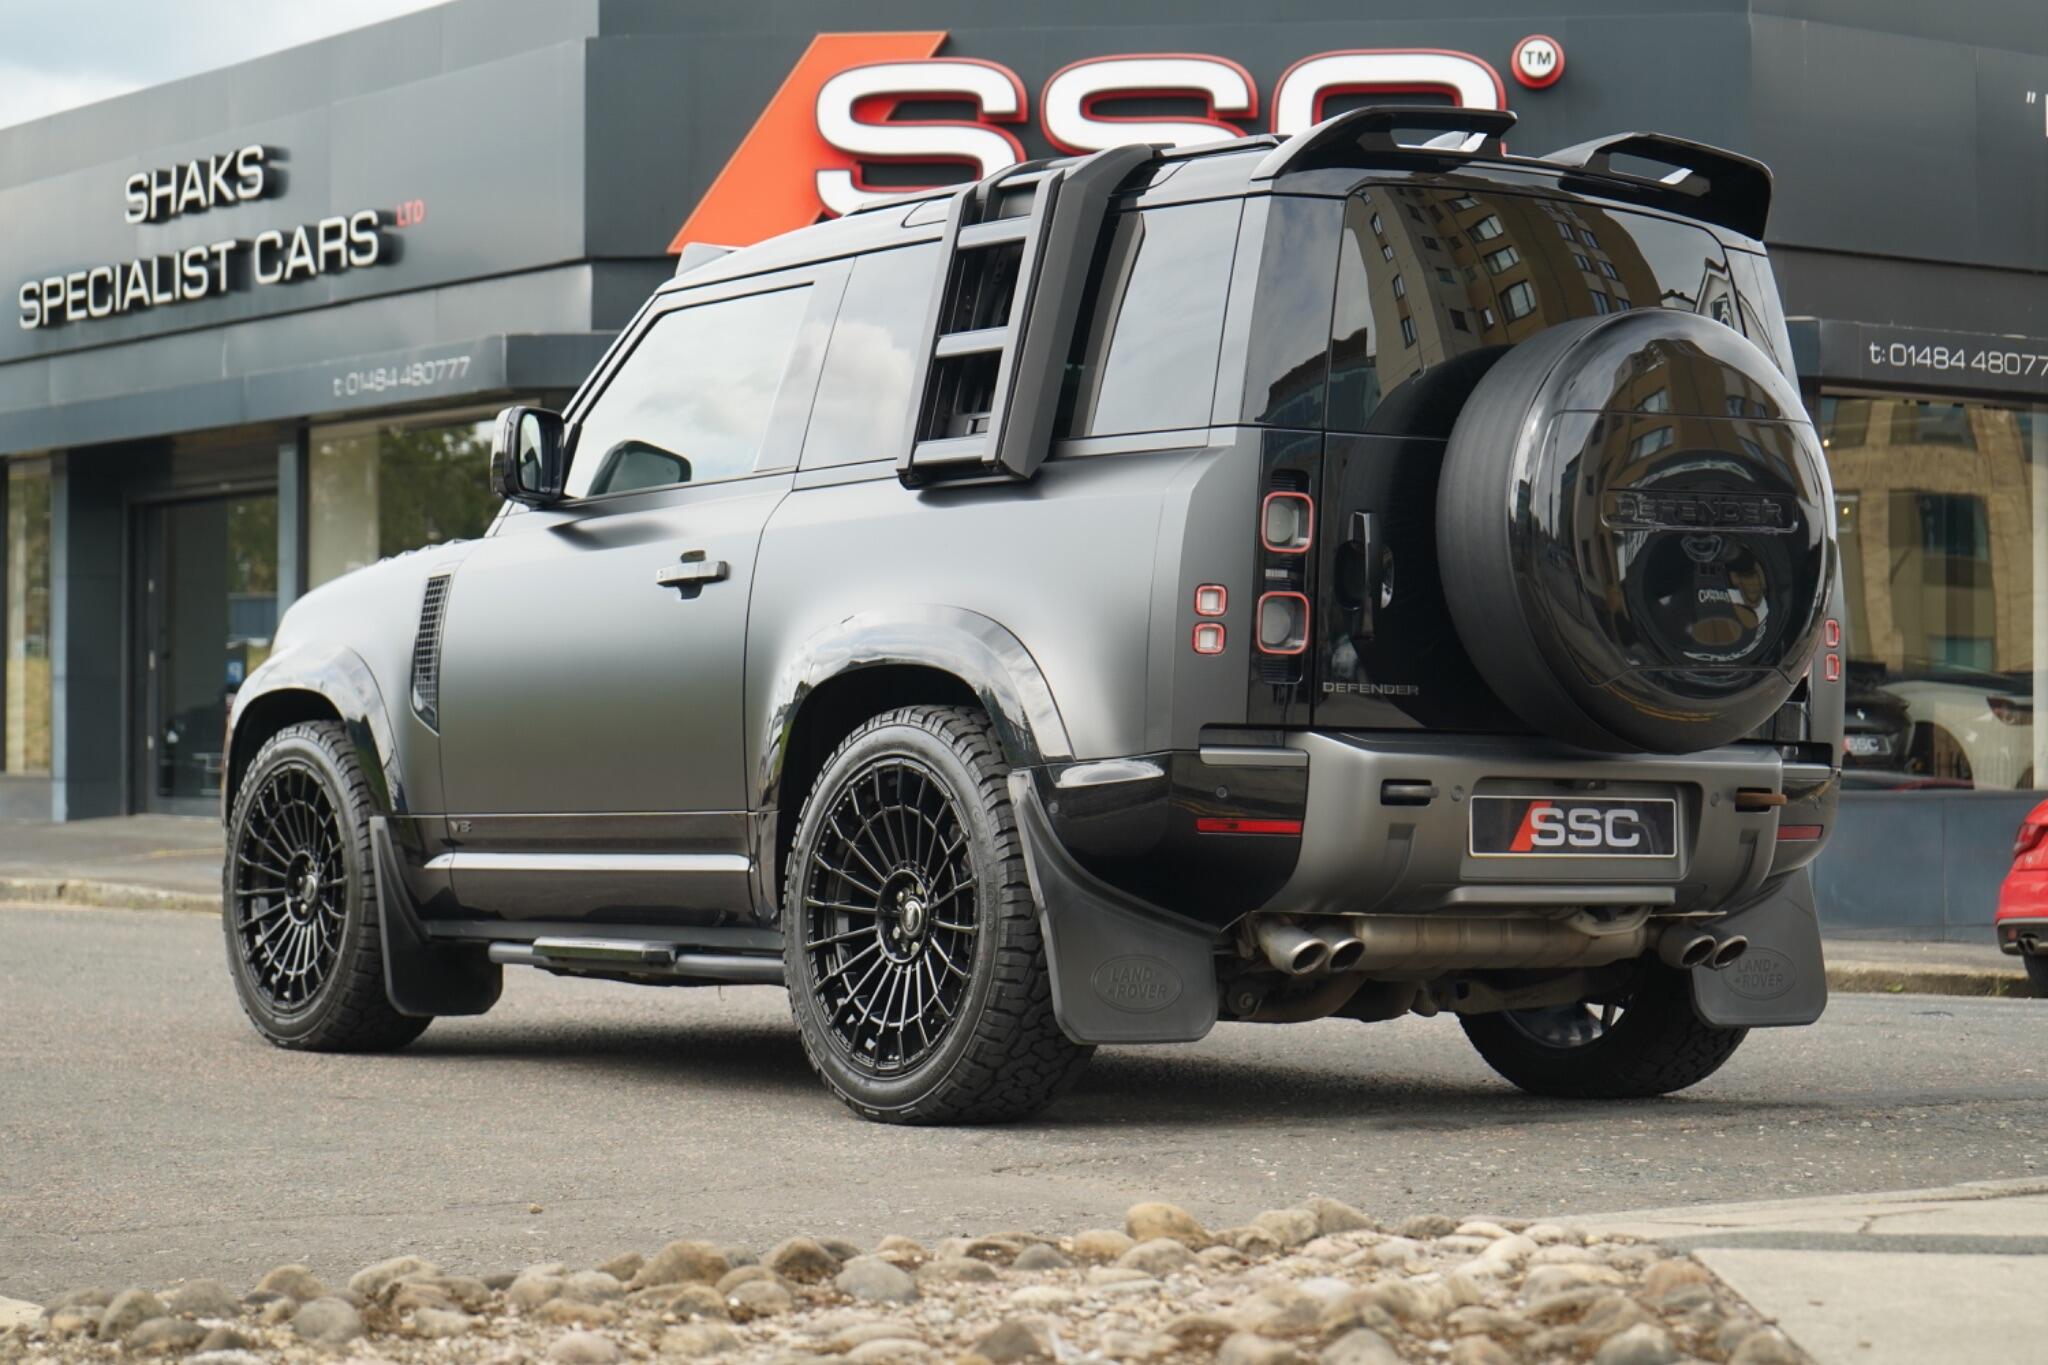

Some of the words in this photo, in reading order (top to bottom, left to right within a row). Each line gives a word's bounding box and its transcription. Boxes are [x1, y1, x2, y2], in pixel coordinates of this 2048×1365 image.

[1525, 51, 1552, 65] TM
[125, 144, 265, 225] SHAKS
[19, 239, 236, 330] SPECIALIST
[253, 209, 379, 285] CARS
[396, 199, 425, 227] LTD
[1617, 498, 1783, 524] DEFENDER
[1323, 682, 1419, 696] DEFENDER
[1530, 807, 1640, 848] SSC
[1737, 958, 1773, 974] LAND
[1110, 967, 1153, 983] LAND
[1742, 973, 1785, 990] ROVER
[1114, 983, 1168, 1000] ROVER
